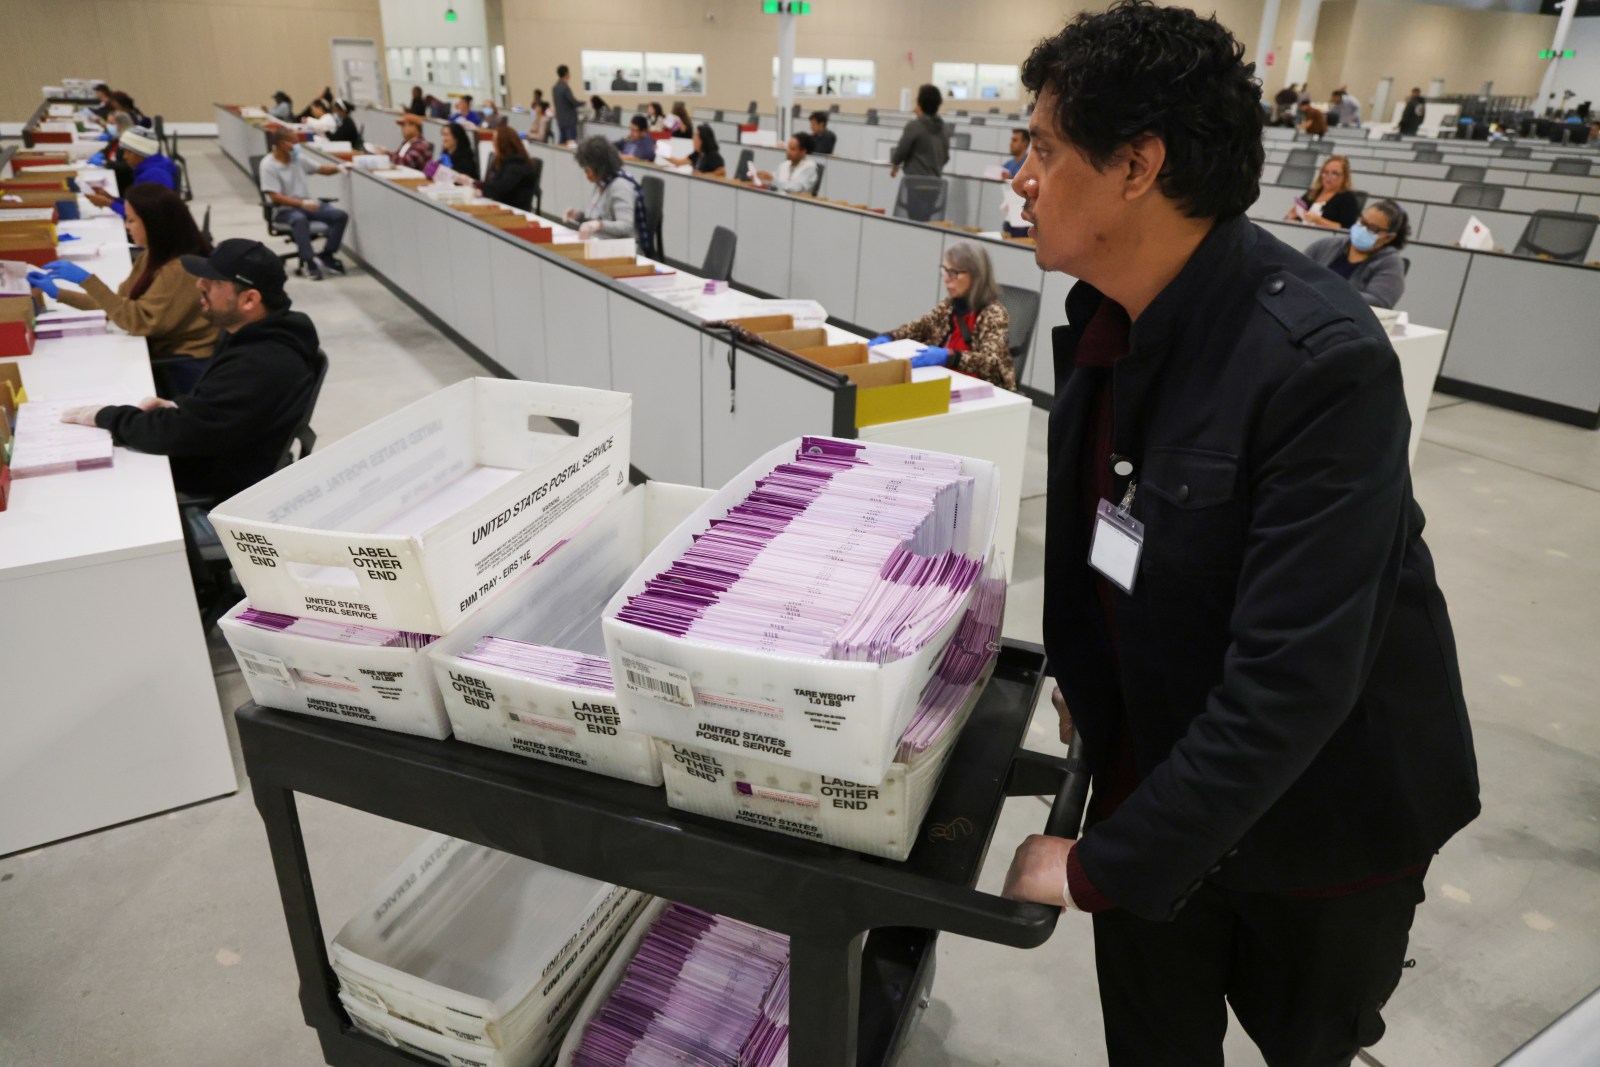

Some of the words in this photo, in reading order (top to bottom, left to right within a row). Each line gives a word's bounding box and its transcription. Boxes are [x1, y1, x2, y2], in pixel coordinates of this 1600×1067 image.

[471, 508, 513, 545] UNITED
[512, 481, 549, 518] STATES
[549, 459, 582, 493] POSTAL
[581, 435, 615, 468] SERVICE
[230, 529, 273, 546] LABEL
[236, 542, 280, 558] OTHER
[348, 545, 398, 558] LABEL
[249, 554, 277, 568] END
[353, 557, 403, 570] OTHER
[367, 569, 398, 582] END
[459, 591, 478, 613] EMM
[478, 575, 498, 597] TRAY
[502, 559, 519, 579] EIRS
[304, 596, 337, 607] UNITED
[337, 600, 371, 612] STATES
[305, 604, 338, 615] POSTAL
[340, 609, 379, 620] SERVICE
[358, 668, 377, 676] TARE
[375, 670, 404, 678] WEIGHT
[448, 670, 492, 691] LABEL
[451, 681, 496, 702] OTHER
[626, 683, 639, 692] SAT
[793, 688, 818, 698] TARE
[818, 691, 856, 702] WEIGHT
[306, 697, 338, 709] UNITED
[338, 702, 371, 715] STATES
[463, 695, 490, 710] END
[571, 700, 620, 716] LABEL
[808, 697, 822, 705] 1.0
[823, 699, 842, 708] LBS
[306, 703, 340, 716] POSTAL
[341, 709, 378, 722] SERVICE
[586, 723, 618, 736] END
[698, 722, 741, 738] UNITED
[742, 731, 787, 748] STATES
[513, 737, 546, 750] UNITED
[547, 744, 582, 759] STATES
[695, 730, 741, 747] POSTAL
[742, 740, 792, 758] SERVICE
[512, 743, 548, 757] POSTAL
[549, 751, 588, 766] SERVICE
[671, 744, 723, 767] LABEL
[674, 754, 725, 777] OTHER
[686, 766, 717, 784] END
[820, 786, 879, 800] OTHER
[832, 798, 868, 811] END
[735, 813, 777, 828] POSTAL
[778, 823, 824, 839] SERVICE
[737, 809, 777, 823] UNITED
[778, 817, 819, 832] STATES
[543, 950, 579, 997] UNITED
